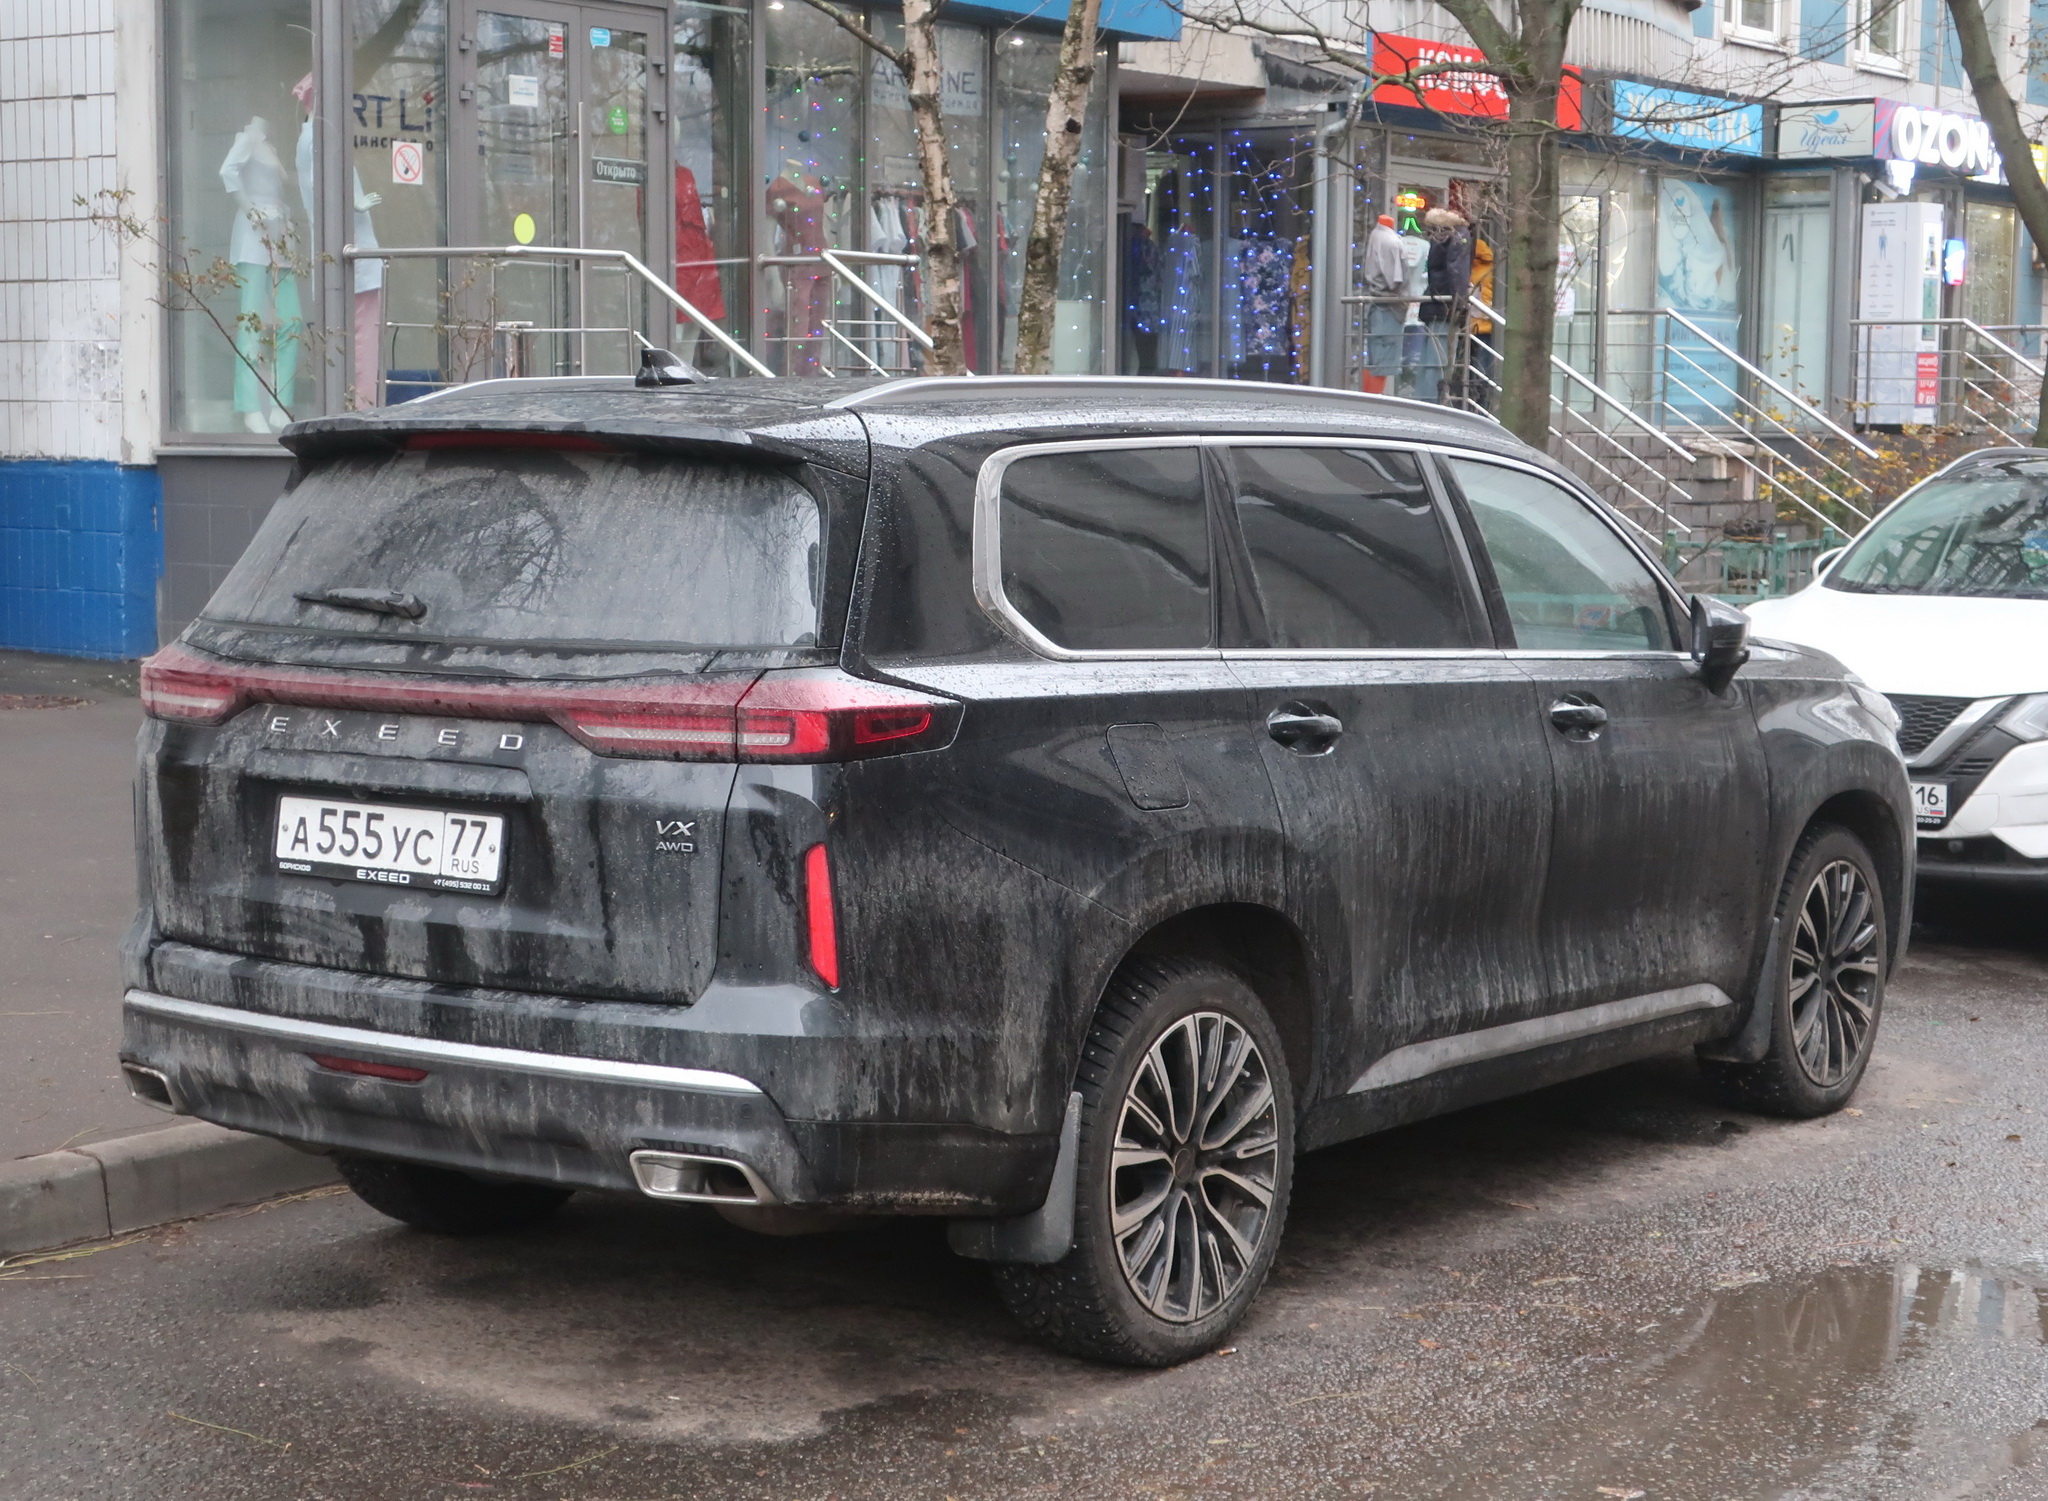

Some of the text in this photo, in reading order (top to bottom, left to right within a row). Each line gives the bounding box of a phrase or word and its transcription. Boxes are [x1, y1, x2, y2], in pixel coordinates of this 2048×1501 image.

[1625, 92, 1752, 146] ХИМЧИСТКА
[1892, 106, 1990, 171] OZON
[596, 160, 636, 180] Открыто
[271, 716, 523, 750] EXEED
[1911, 785, 1939, 806] 16
[450, 818, 487, 858] 77
[656, 820, 695, 836] VX
[655, 841, 693, 852] AWD
[451, 858, 480, 874] RUS
[356, 869, 410, 884] EXEED
